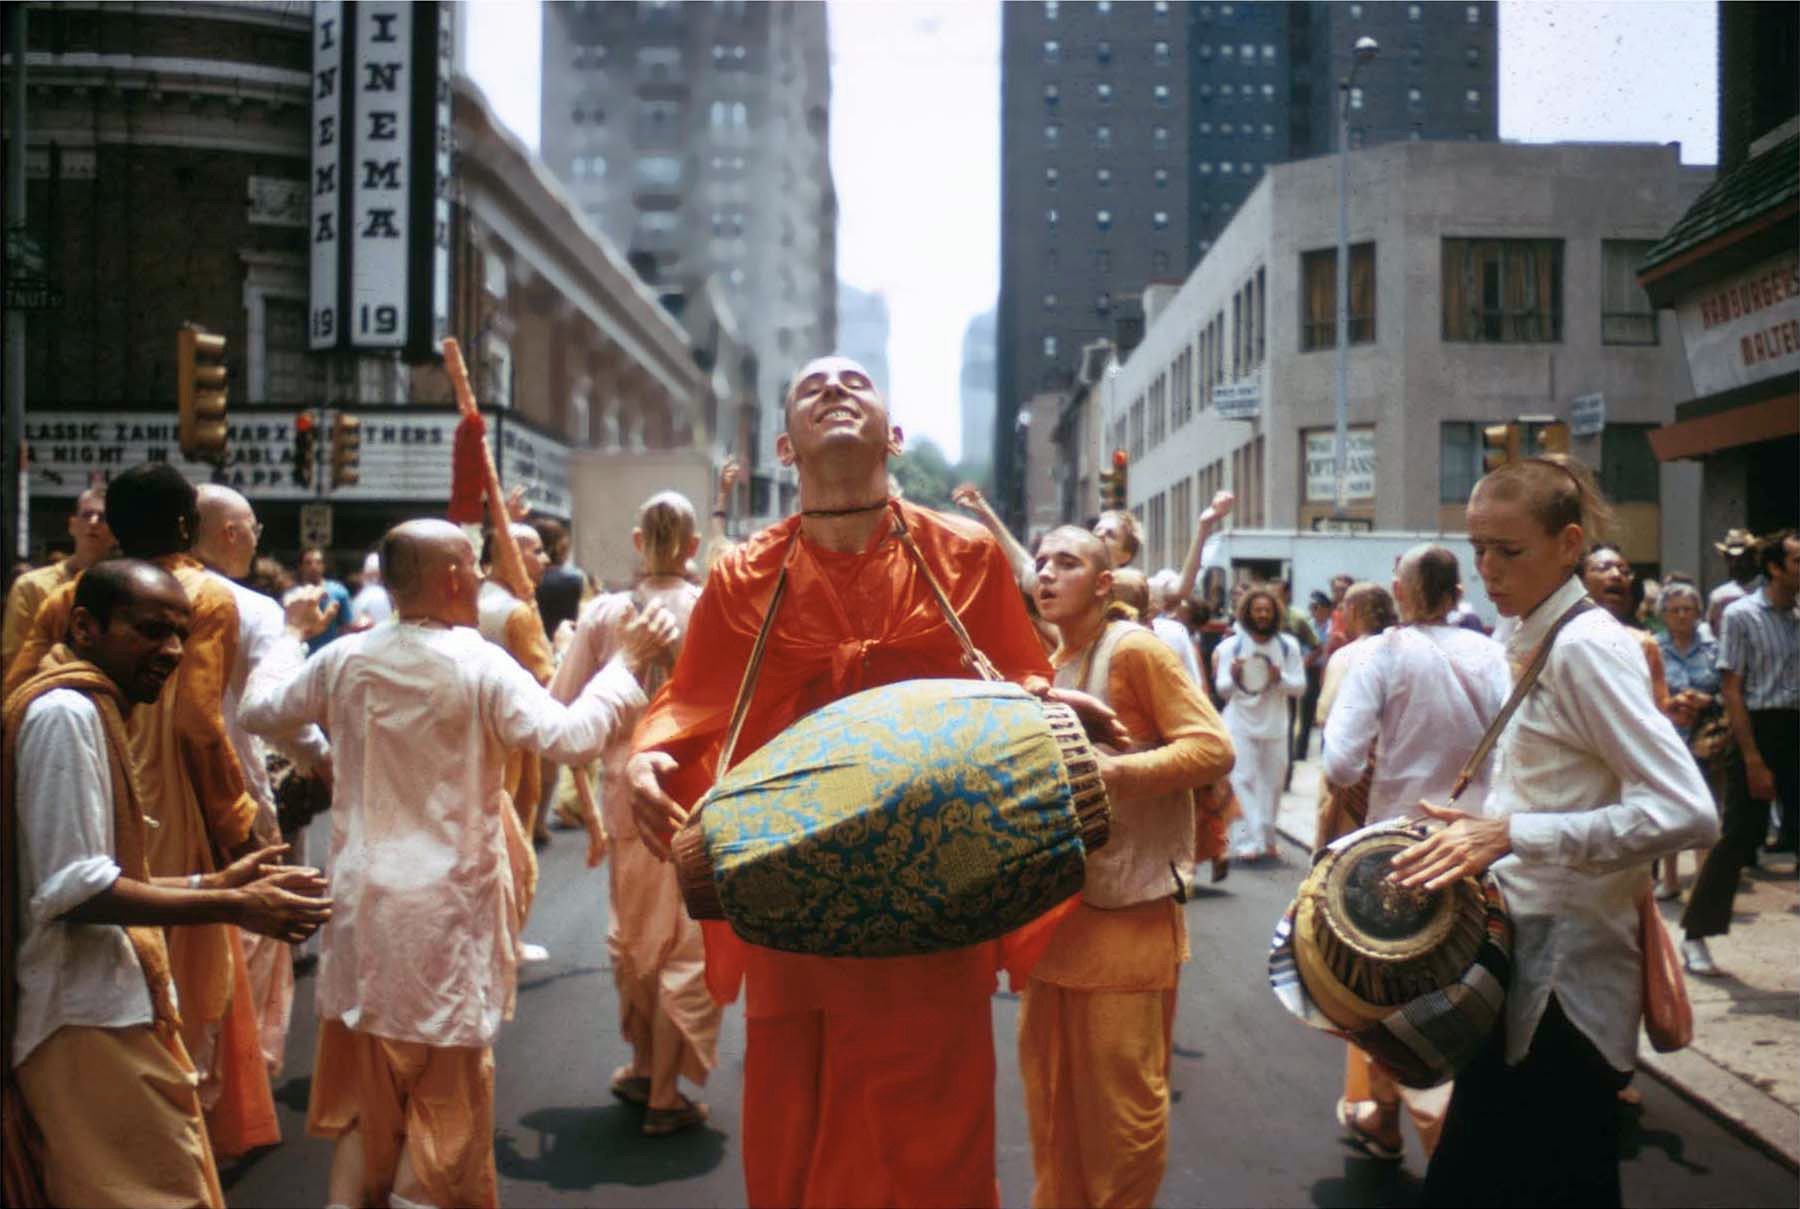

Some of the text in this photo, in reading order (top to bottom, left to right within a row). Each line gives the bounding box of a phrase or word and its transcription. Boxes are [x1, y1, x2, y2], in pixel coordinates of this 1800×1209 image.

[312, 308, 334, 337] 19
[360, 304, 398, 335] 19
[25, 423, 98, 441] LASSIC
[52, 447, 124, 463] NIGHT
